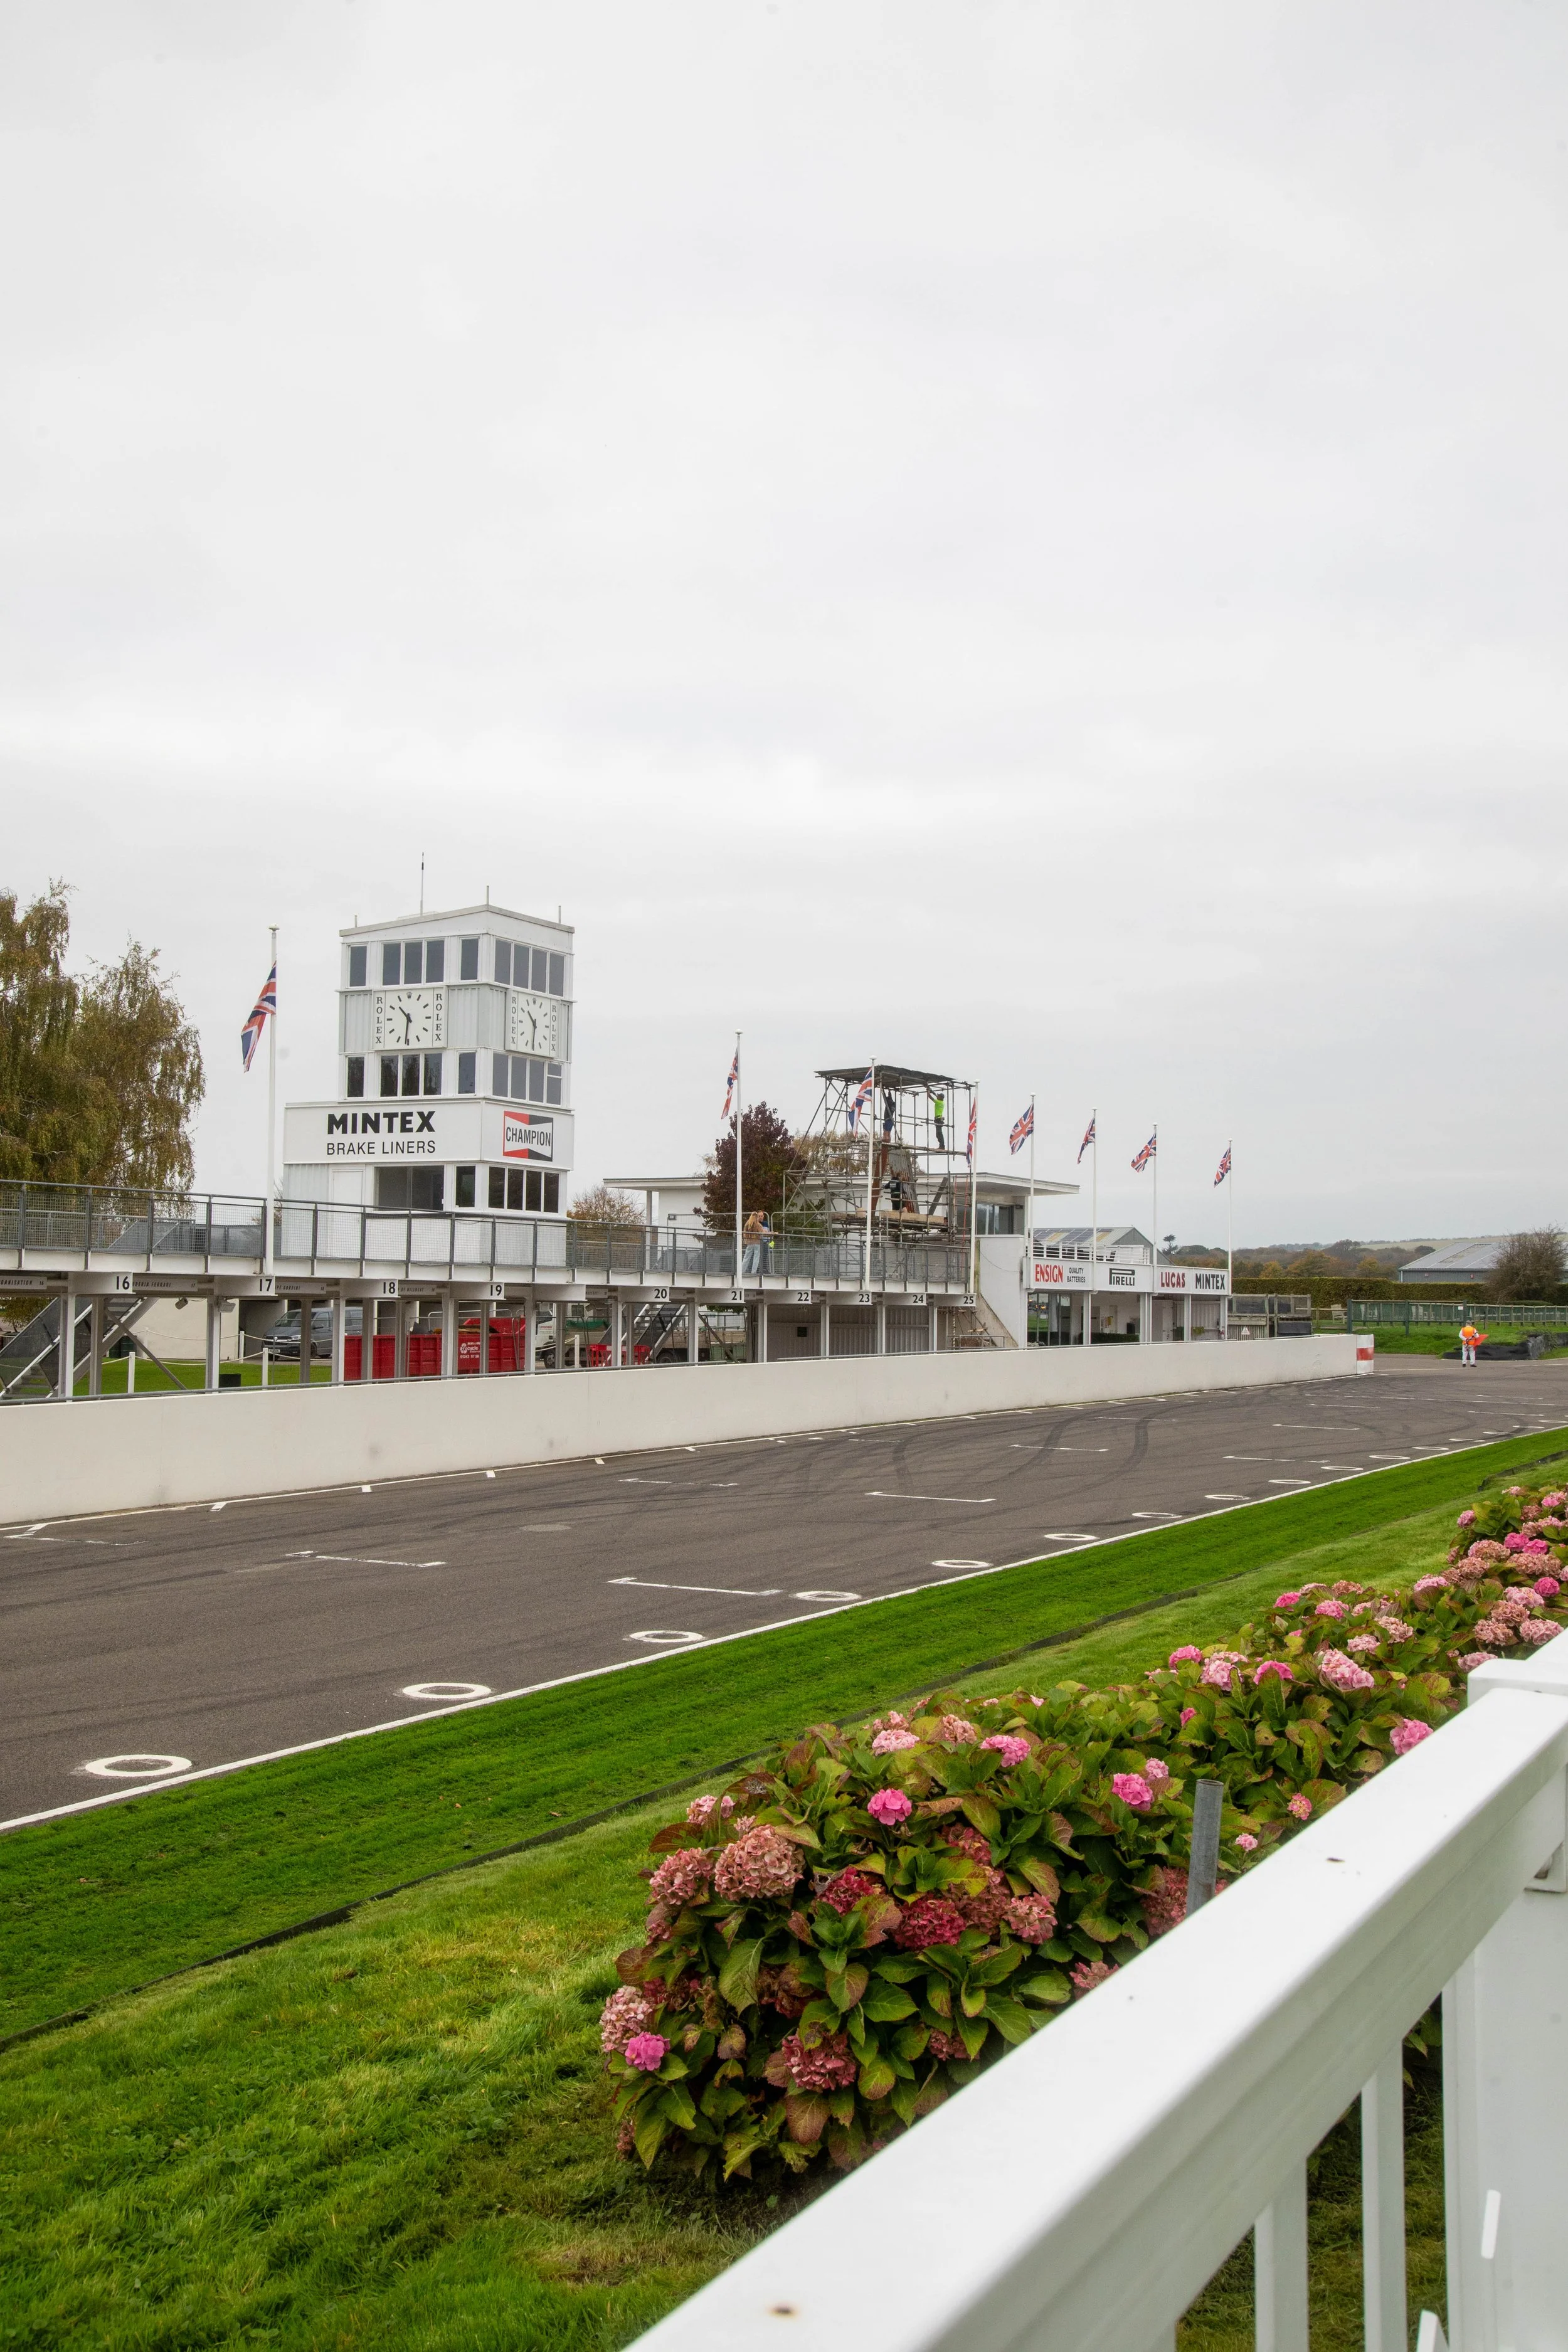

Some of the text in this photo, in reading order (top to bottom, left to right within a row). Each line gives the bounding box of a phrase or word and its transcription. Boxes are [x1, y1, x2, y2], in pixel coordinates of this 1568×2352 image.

[327, 1111, 436, 1135] MINTEX
[506, 1126, 551, 1147] CHAMPION
[326, 1140, 436, 1155] BRAKE LINERS
[1035, 1264, 1063, 1283] ENSIGN
[1109, 1268, 1135, 1286] PIRELLI
[1160, 1271, 1185, 1288] LUCAS
[116, 1276, 130, 1290] 16
[259, 1278, 273, 1292] 17
[383, 1281, 396, 1294] 18
[1195, 1273, 1226, 1290] MINTEX
[490, 1285, 502, 1296] 19
[654, 1288, 667, 1299] 20
[731, 1291, 742, 1301] 21
[797, 1292, 810, 1301] 22
[859, 1293, 870, 1303] 23
[913, 1295, 924, 1303] 24
[963, 1296, 974, 1305] 25
